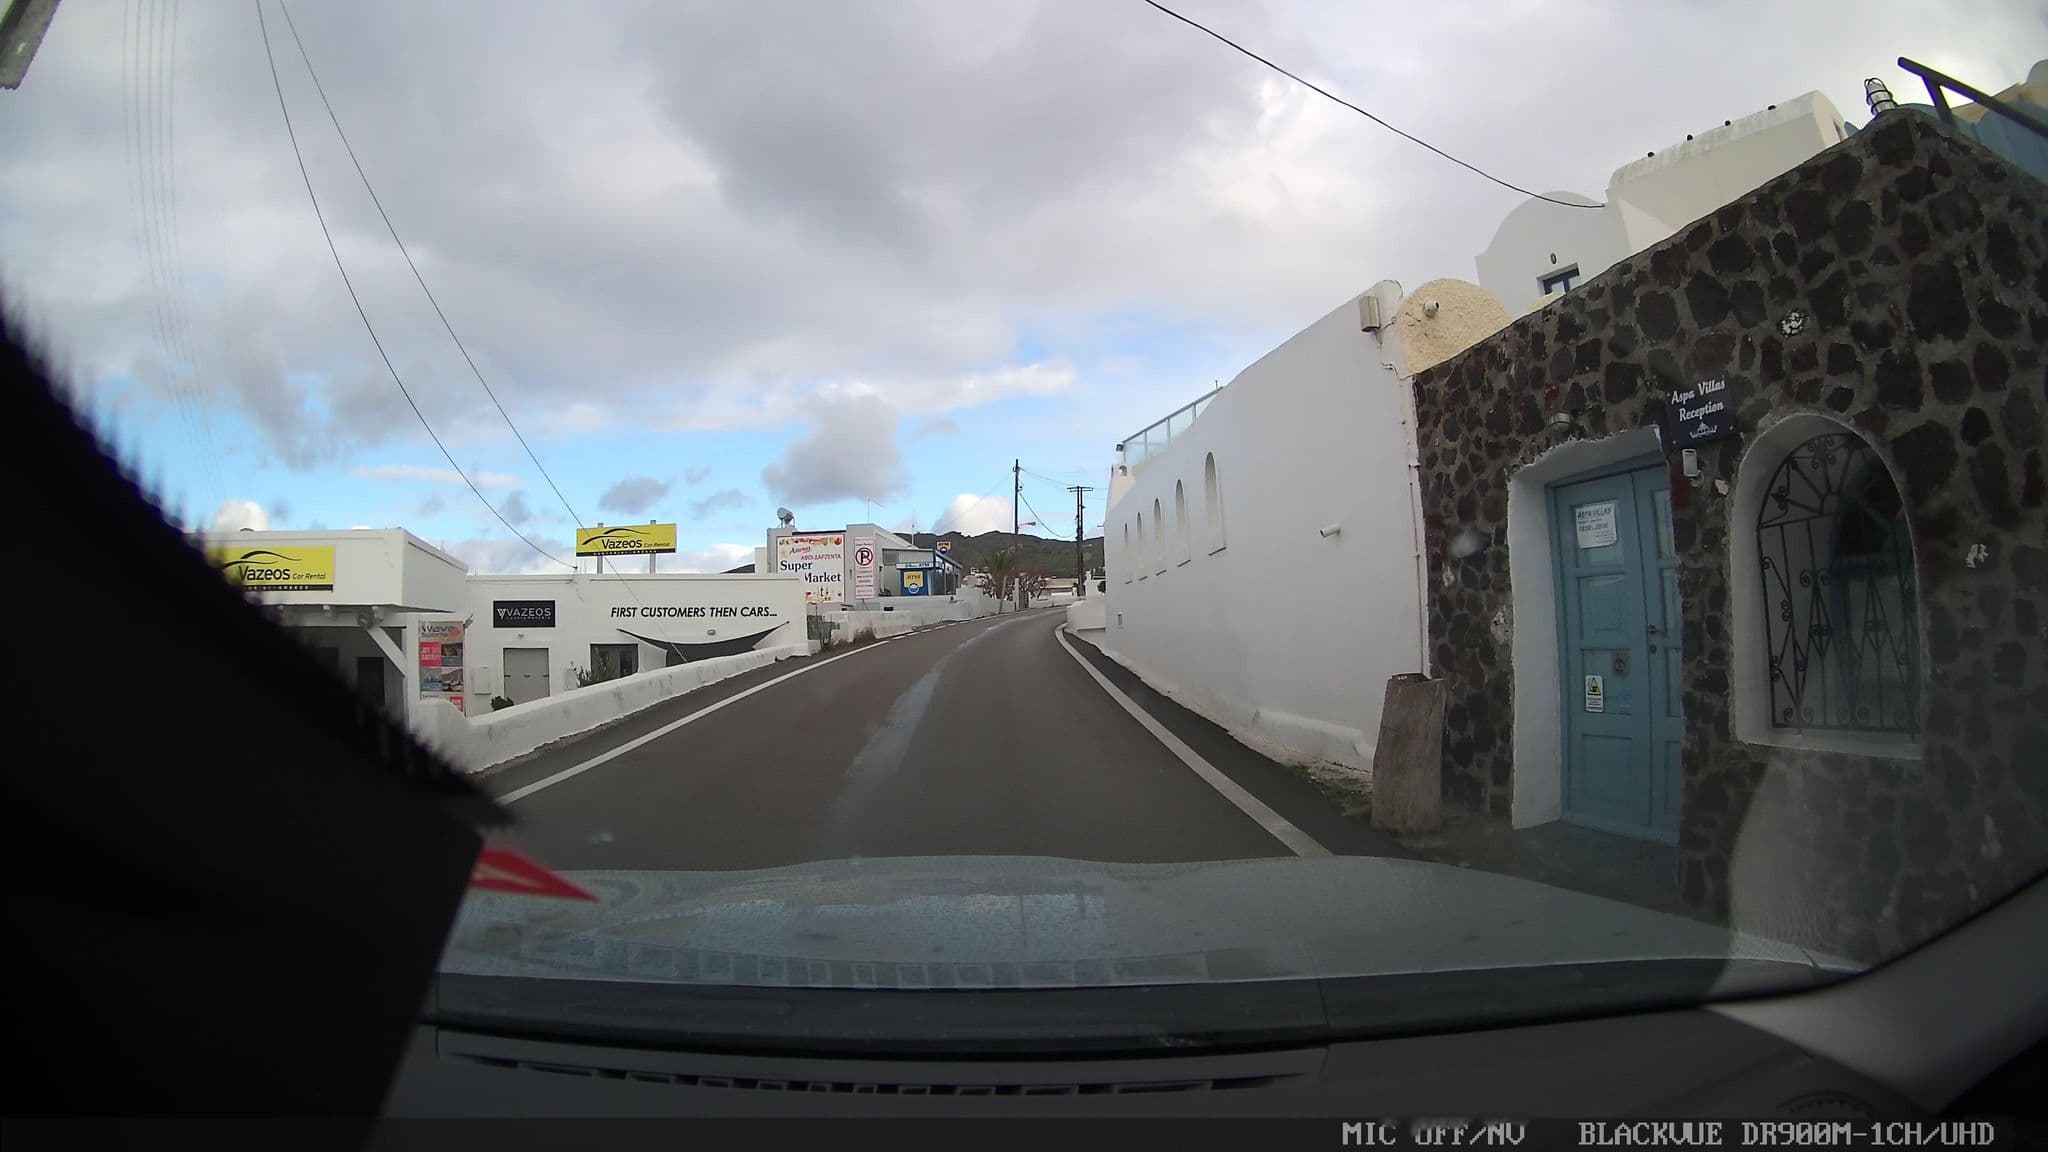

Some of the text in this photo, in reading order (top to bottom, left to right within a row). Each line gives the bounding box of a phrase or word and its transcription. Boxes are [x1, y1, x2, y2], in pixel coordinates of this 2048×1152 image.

[1671, 379, 1725, 405] Aspa Villas
[1679, 401, 1725, 422] Reception
[601, 539, 643, 549] Vazeos
[780, 560, 813, 573] Super
[239, 565, 291, 581] Vazeos
[804, 572, 841, 583] Market
[506, 607, 552, 617] VAZEOS
[610, 606, 778, 618] FIRST CUSTOMERS THEN CARS...
